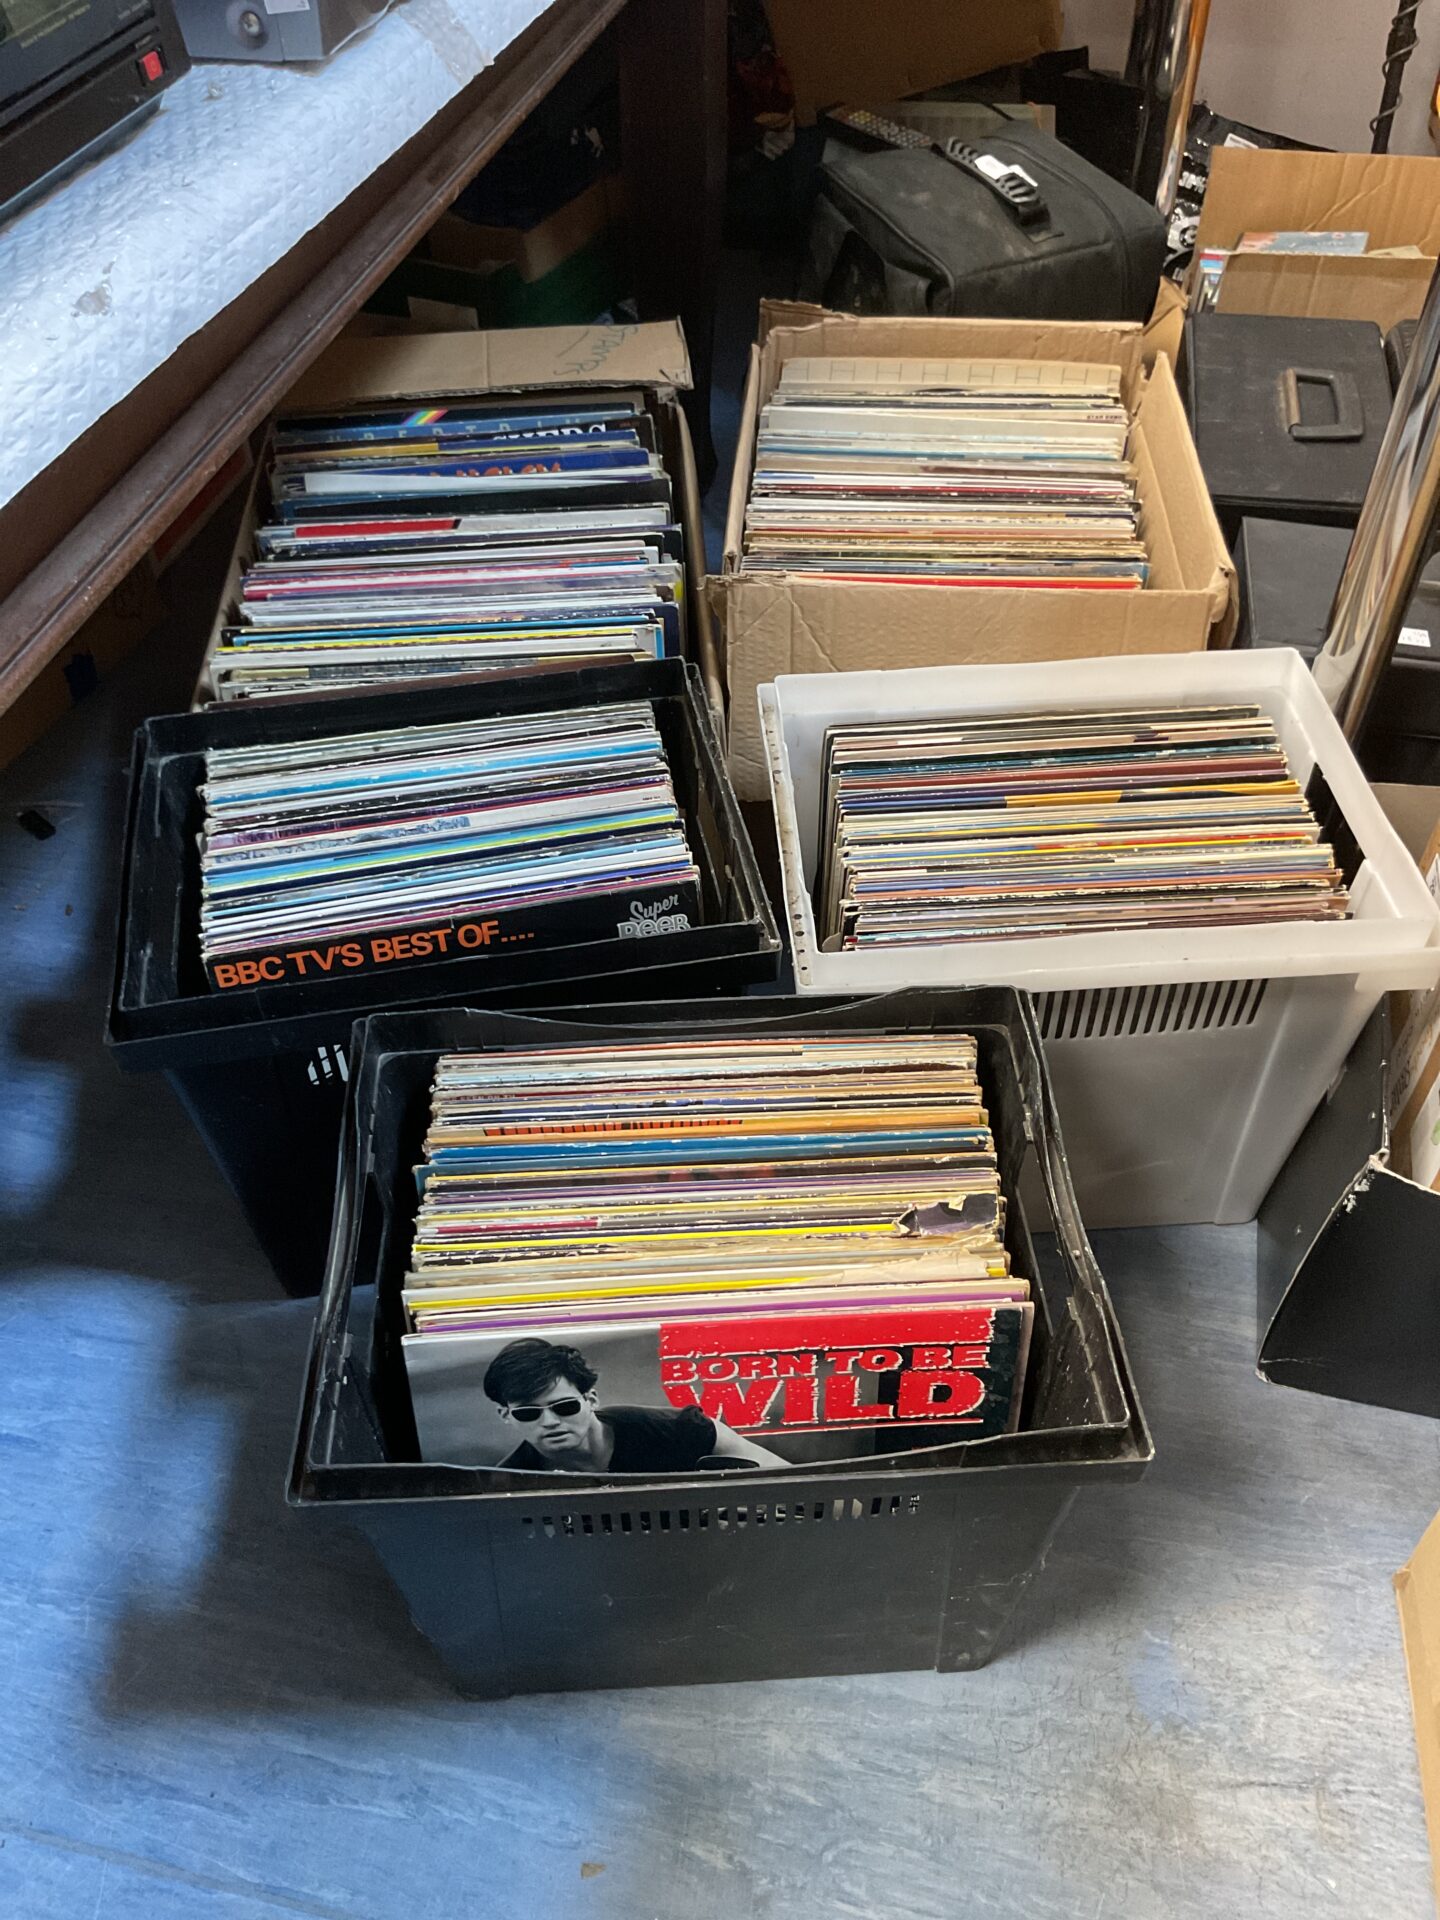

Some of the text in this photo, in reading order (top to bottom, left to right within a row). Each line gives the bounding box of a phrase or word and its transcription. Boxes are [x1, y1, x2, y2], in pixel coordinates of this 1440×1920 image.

[629, 894, 680, 923] Super
[213, 956, 286, 989] BBC
[286, 943, 365, 976] TV'S
[370, 927, 452, 963] BEST
[661, 1344, 991, 1385] BORN TO BE
[661, 1369, 985, 1429] WILD
